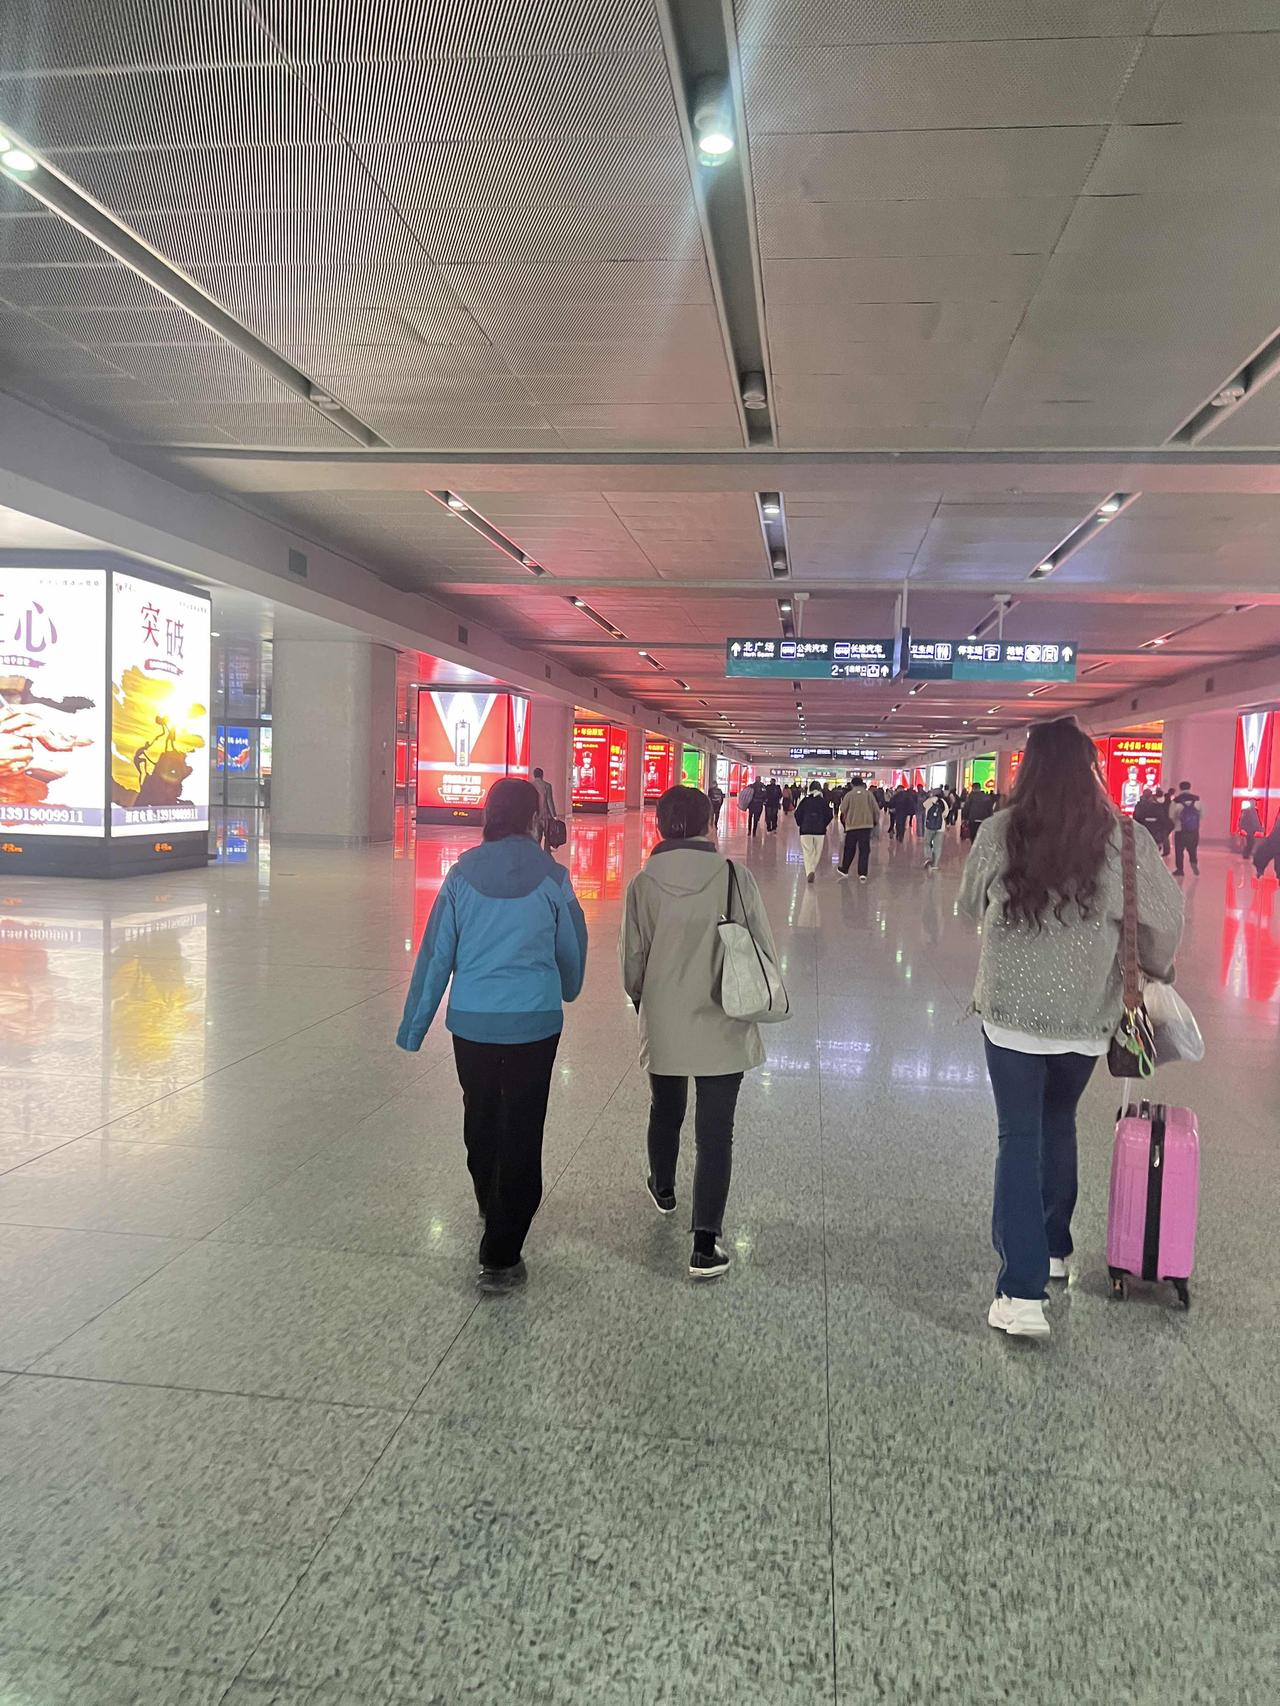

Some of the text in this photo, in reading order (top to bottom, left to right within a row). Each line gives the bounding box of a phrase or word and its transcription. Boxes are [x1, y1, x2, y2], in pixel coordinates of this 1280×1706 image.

[140, 601, 185, 660] 突破
[743, 641, 775, 652] 北广场
[797, 643, 828, 653] 公共汽车
[851, 643, 883, 653] 长途汽车
[910, 645, 934, 655] 卫生间
[958, 645, 983, 655] 停车场
